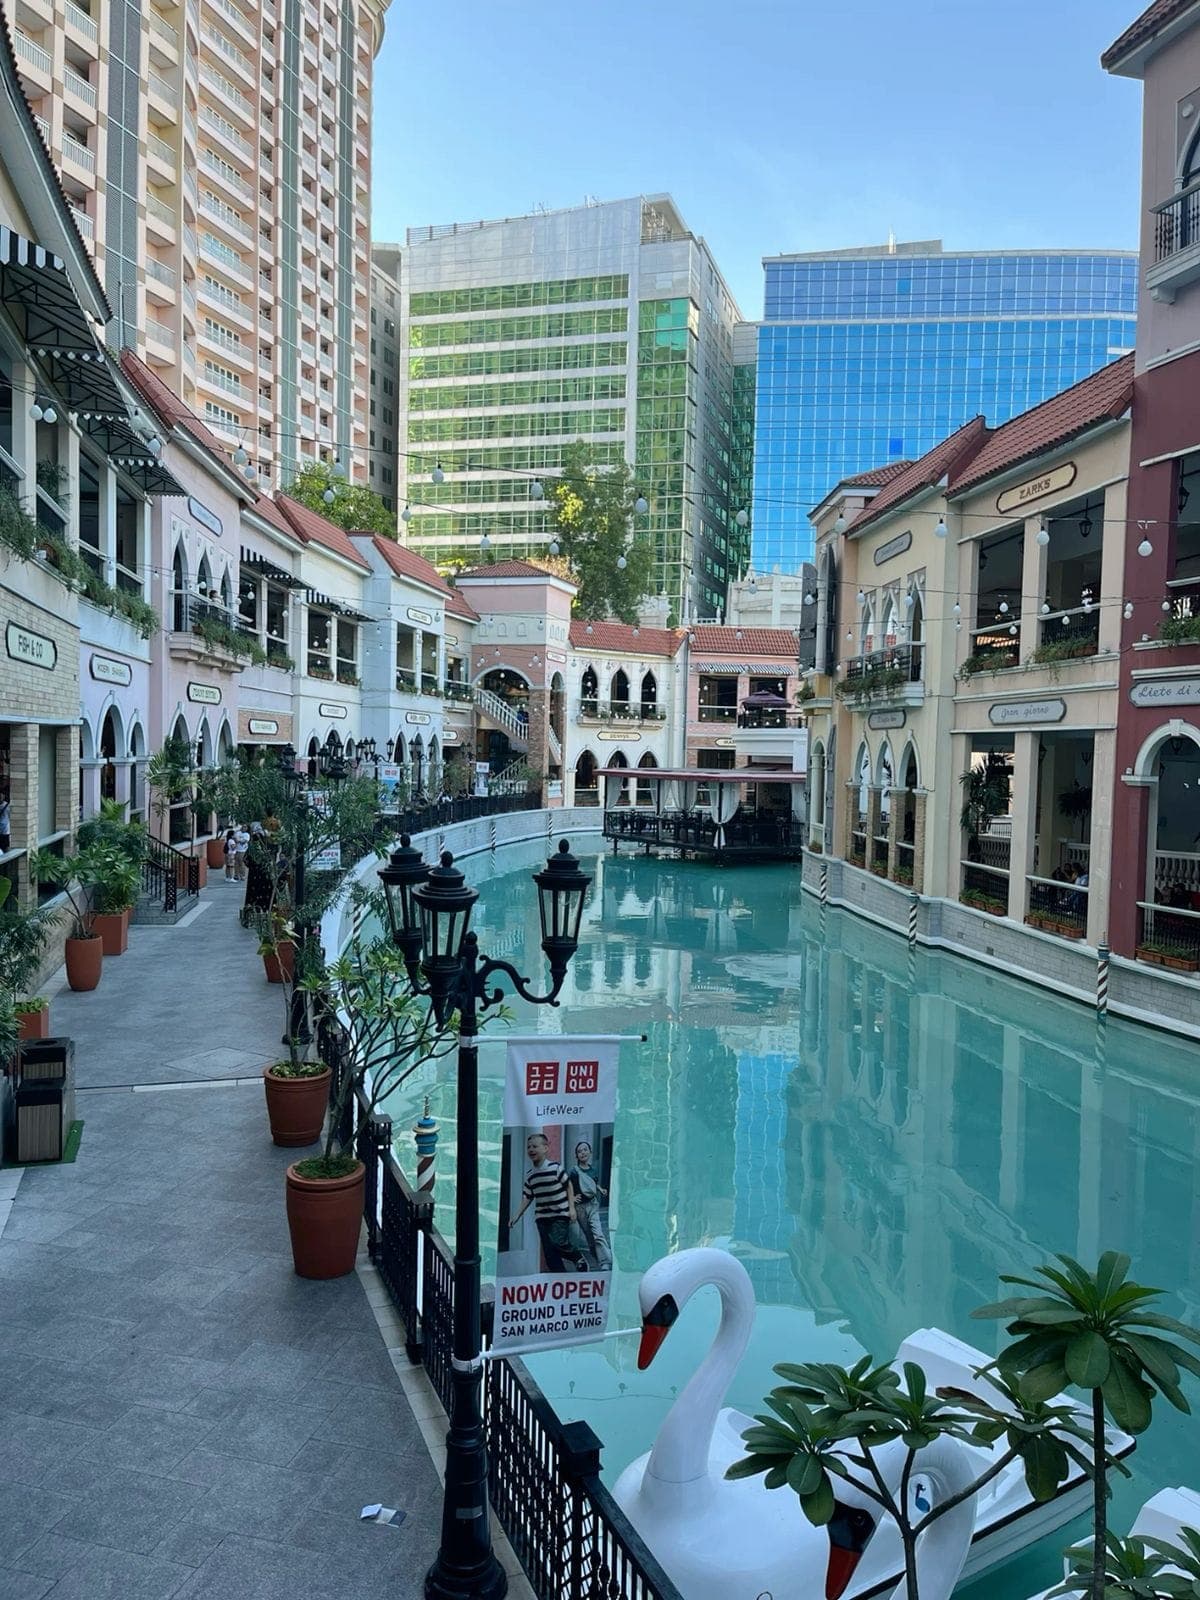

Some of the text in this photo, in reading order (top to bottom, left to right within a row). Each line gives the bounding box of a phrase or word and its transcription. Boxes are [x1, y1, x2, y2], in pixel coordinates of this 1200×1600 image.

[570, 1065, 593, 1077] UNI
[569, 1078, 594, 1091] QLO
[536, 1104, 584, 1116] LifeWear
[502, 1280, 605, 1306] NOW OPEN
[501, 1301, 602, 1323] GROUND LEVEL
[501, 1316, 602, 1338] SAN MARCO WING
